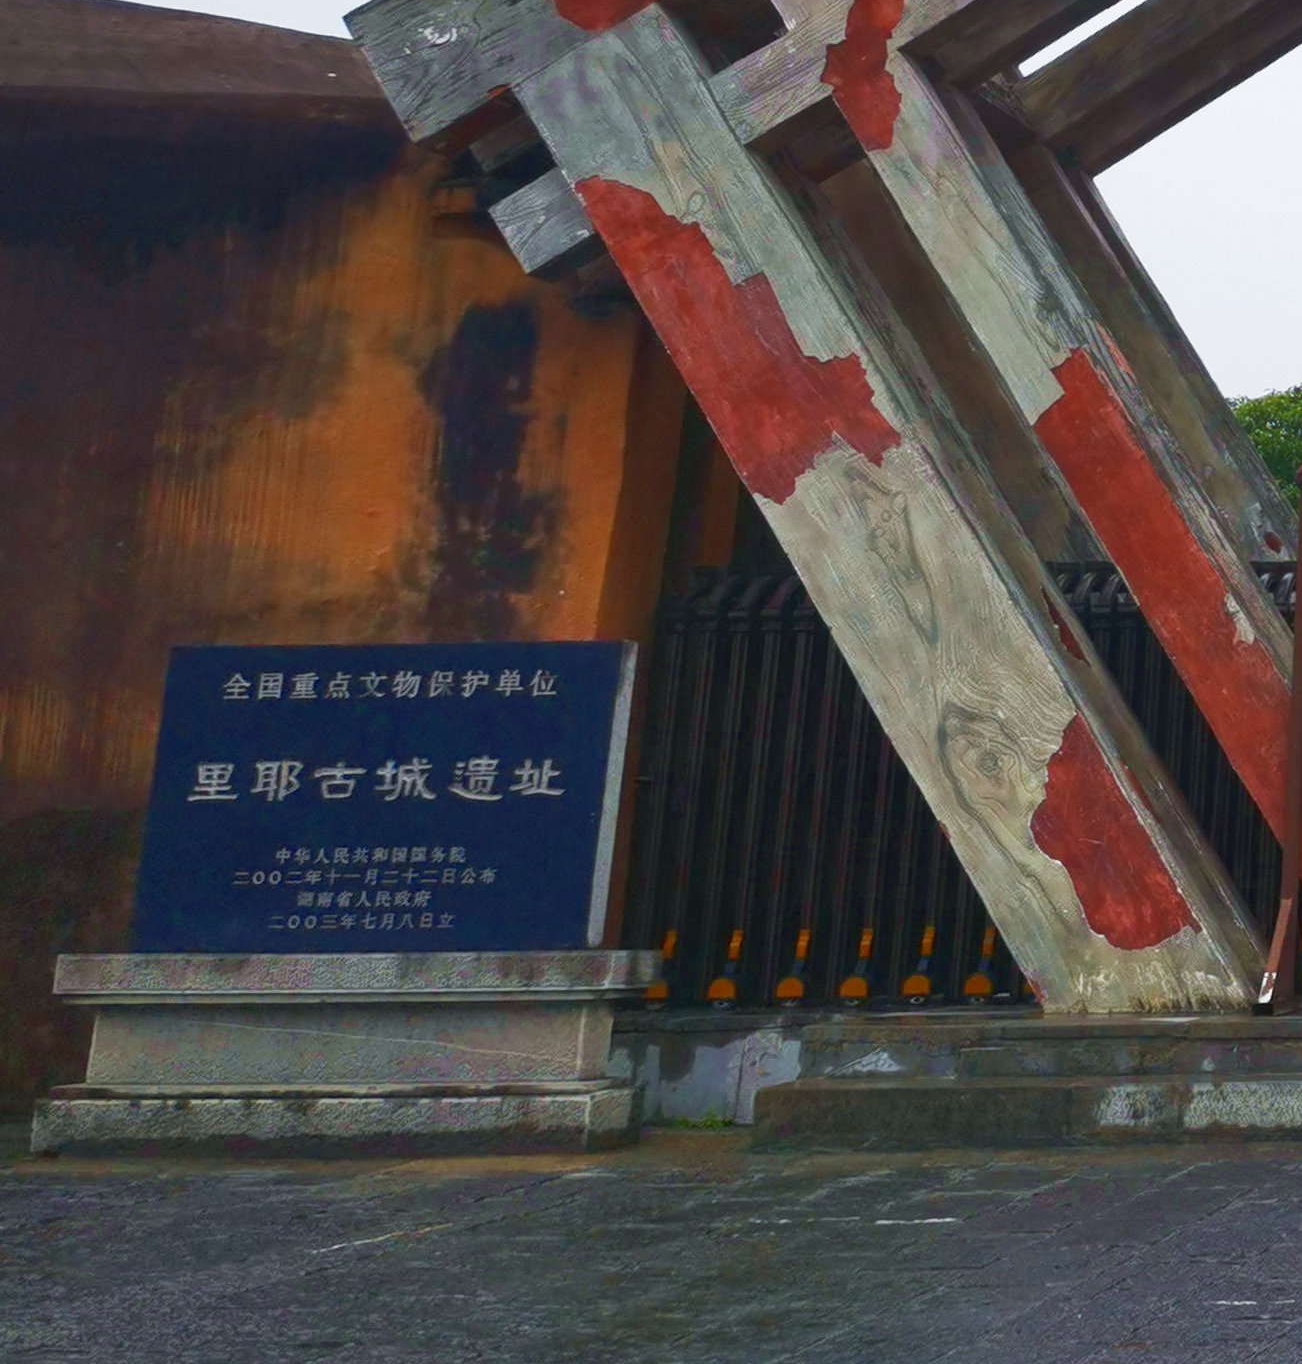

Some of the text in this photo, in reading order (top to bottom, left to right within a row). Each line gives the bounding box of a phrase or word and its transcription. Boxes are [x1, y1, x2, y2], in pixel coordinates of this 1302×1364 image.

[221, 669, 559, 701] 全国重点文物保护单位
[187, 755, 568, 803] 里耶古城遗址
[275, 846, 467, 865] 中华人民共和国国务院
[296, 889, 432, 909] 湖南省人民政府
